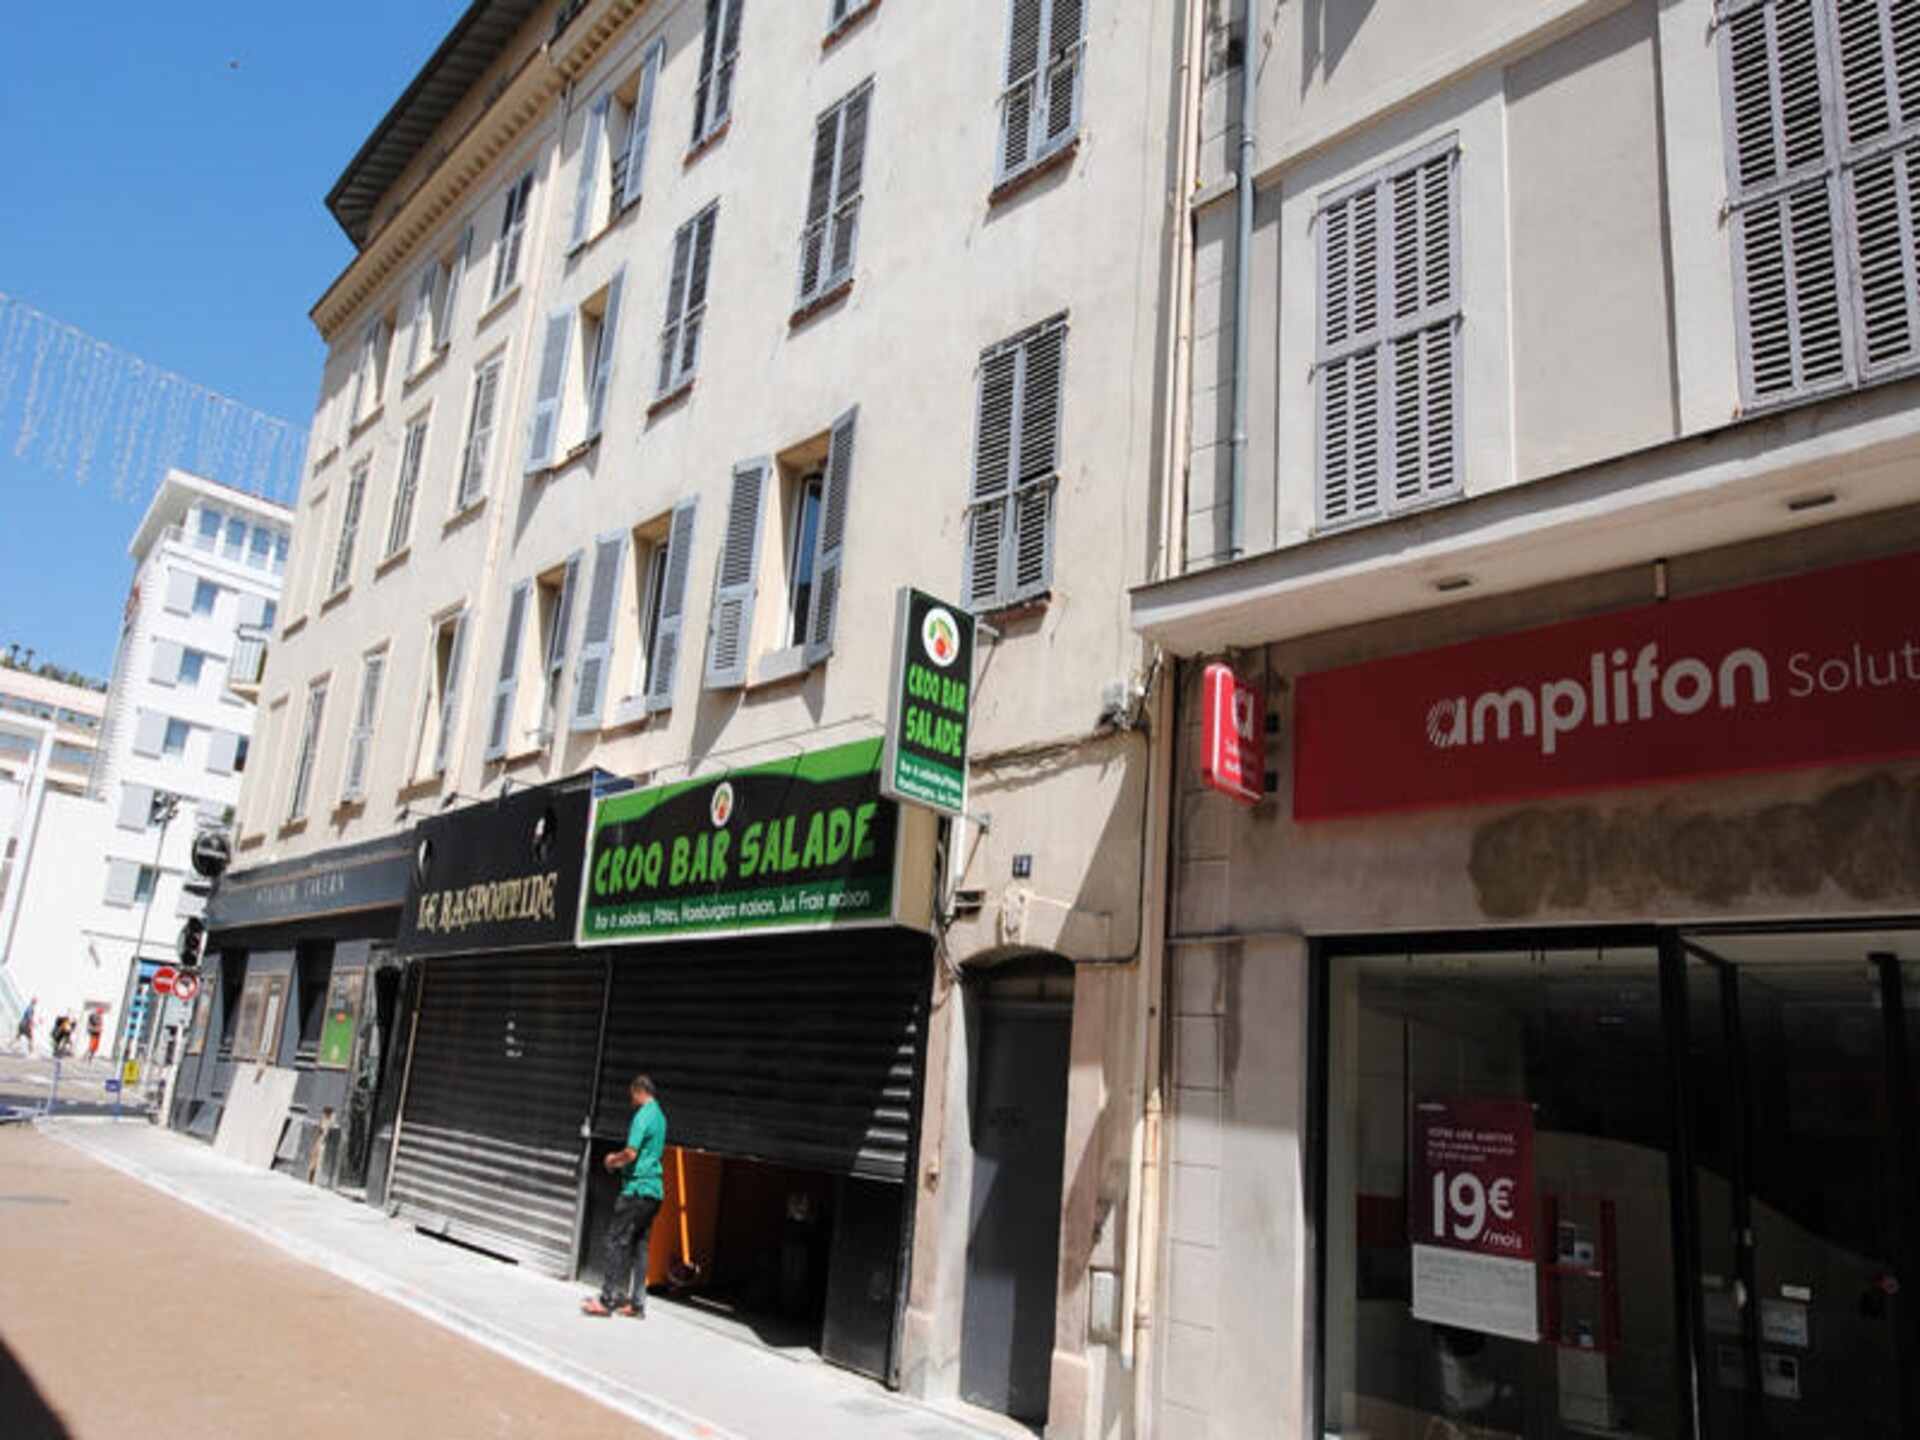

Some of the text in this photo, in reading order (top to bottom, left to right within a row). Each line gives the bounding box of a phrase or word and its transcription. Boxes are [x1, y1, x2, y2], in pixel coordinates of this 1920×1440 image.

[908, 663, 968, 714] CROQ BAR
[1425, 641, 1770, 754] amplifon
[906, 705, 963, 757] SALADE
[593, 802, 878, 896] CROQ BAR SALADE
[1433, 1171, 1515, 1241] 19€
